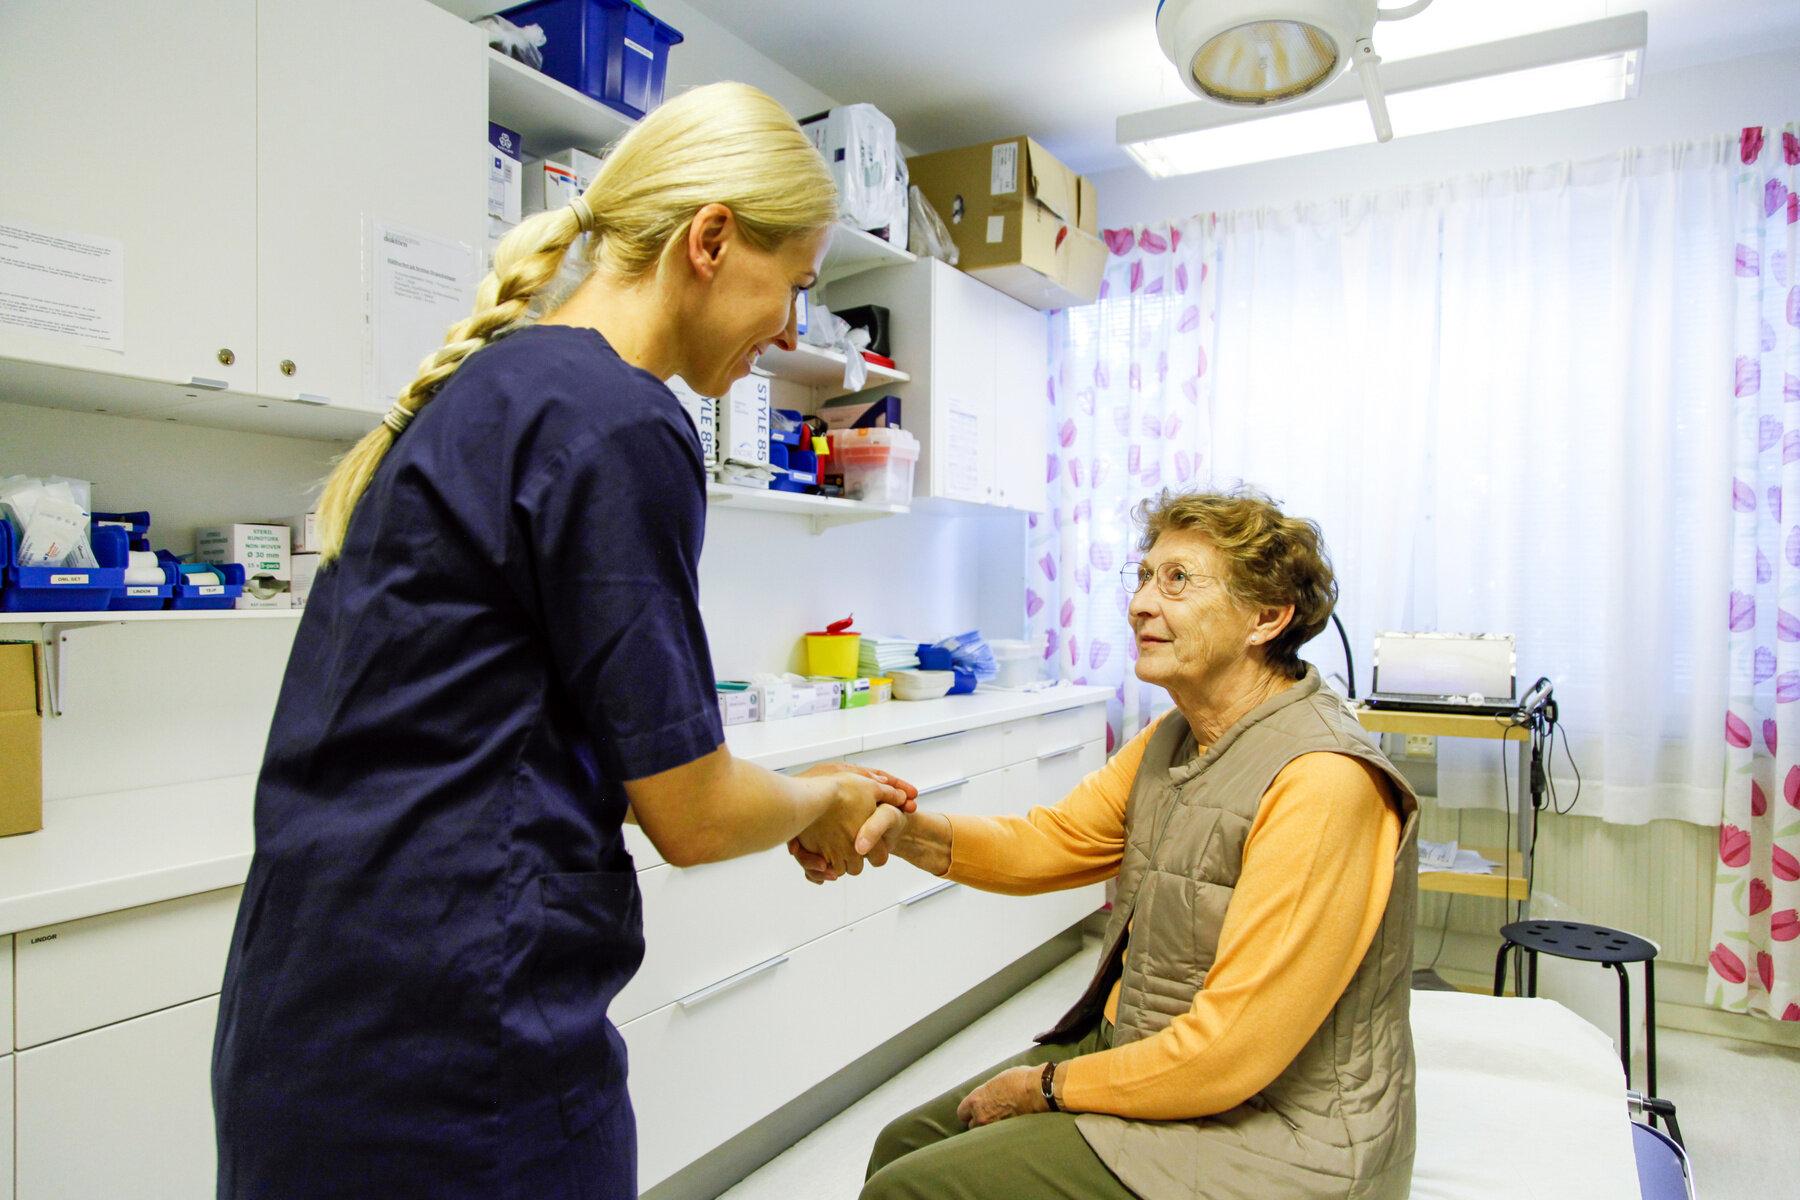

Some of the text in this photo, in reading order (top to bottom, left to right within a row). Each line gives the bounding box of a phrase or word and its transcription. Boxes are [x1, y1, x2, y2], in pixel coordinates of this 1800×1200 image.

[700, 397, 712, 454] YLE 85
[757, 383, 767, 461] STYLE 85
[31, 934, 57, 944] LINDOR
